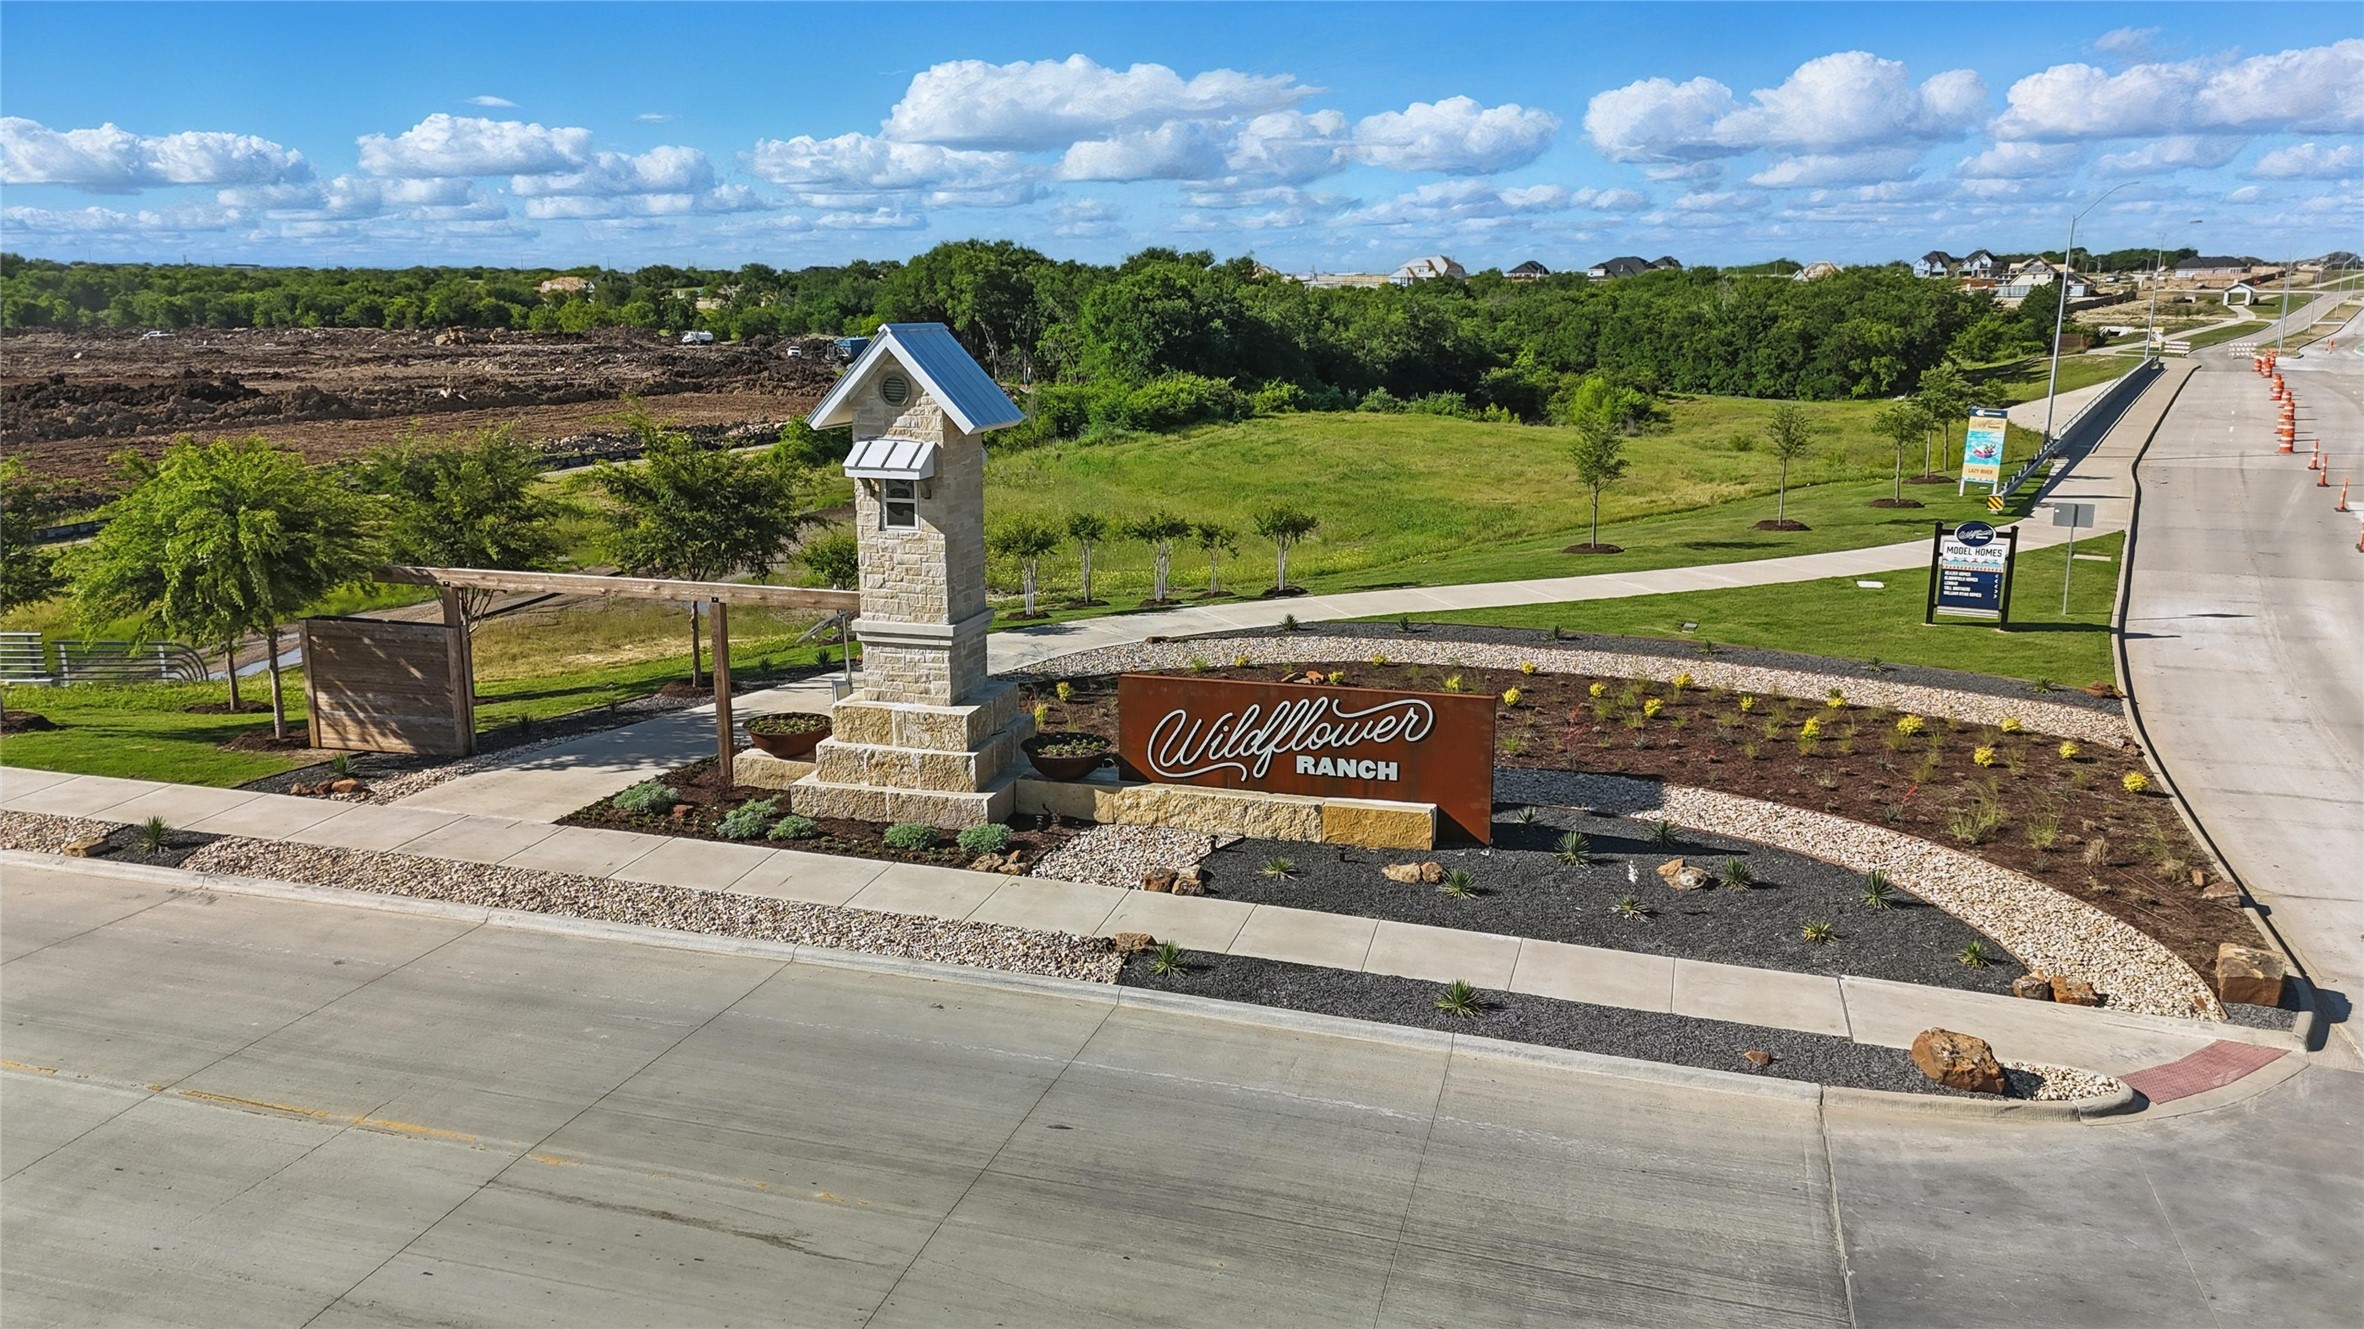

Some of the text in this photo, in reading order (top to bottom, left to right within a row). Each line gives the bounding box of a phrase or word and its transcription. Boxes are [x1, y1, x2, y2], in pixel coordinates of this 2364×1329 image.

[1946, 546, 2003, 557] MODEL HOMES
[1147, 696, 1434, 781] Wildflower
[1296, 755, 1398, 781] RANCH
